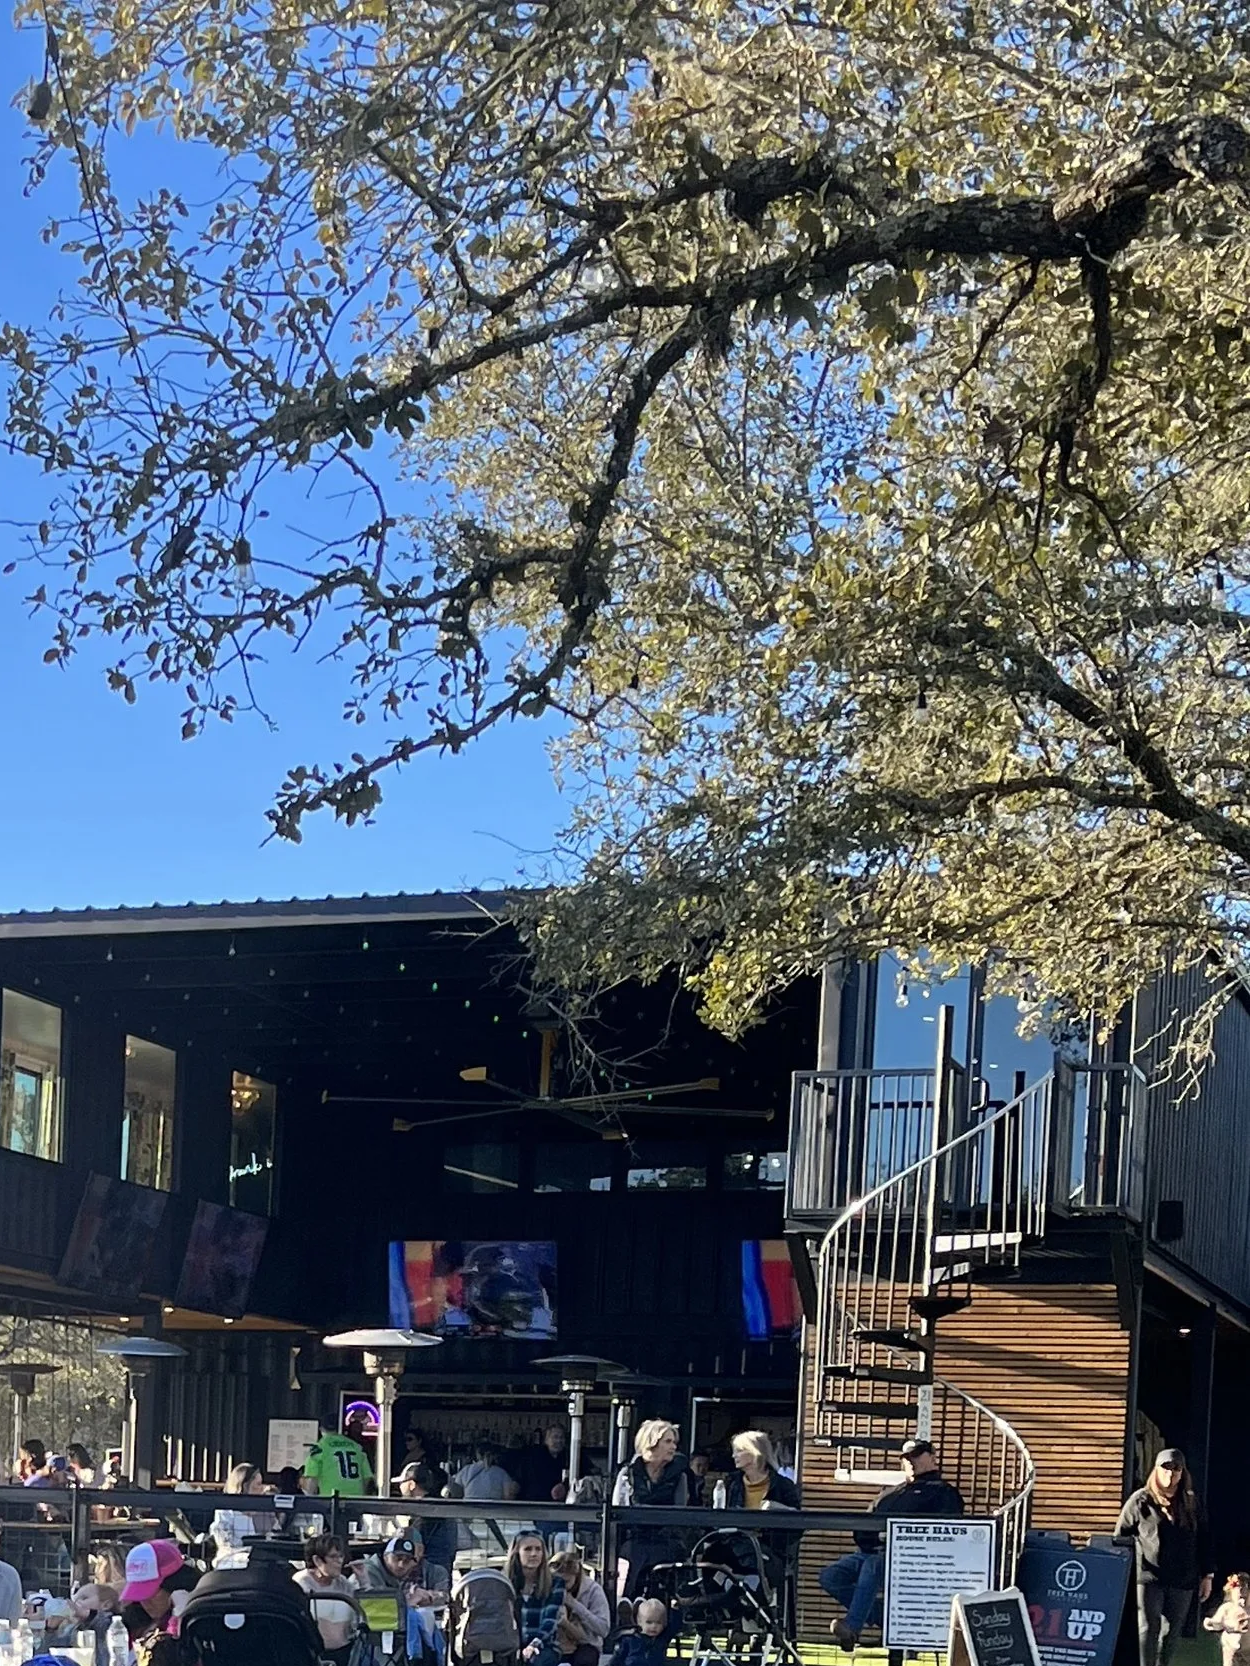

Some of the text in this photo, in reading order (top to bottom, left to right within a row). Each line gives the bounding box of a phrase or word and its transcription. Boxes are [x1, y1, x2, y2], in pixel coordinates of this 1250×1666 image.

[334, 1451, 360, 1479] 16
[896, 1526, 968, 1536] TREE HAUS
[971, 1605, 1012, 1629] Sunday
[1028, 1603, 1064, 1638] 21
[1068, 1608, 1107, 1624] AND
[1066, 1621, 1103, 1641] UP
